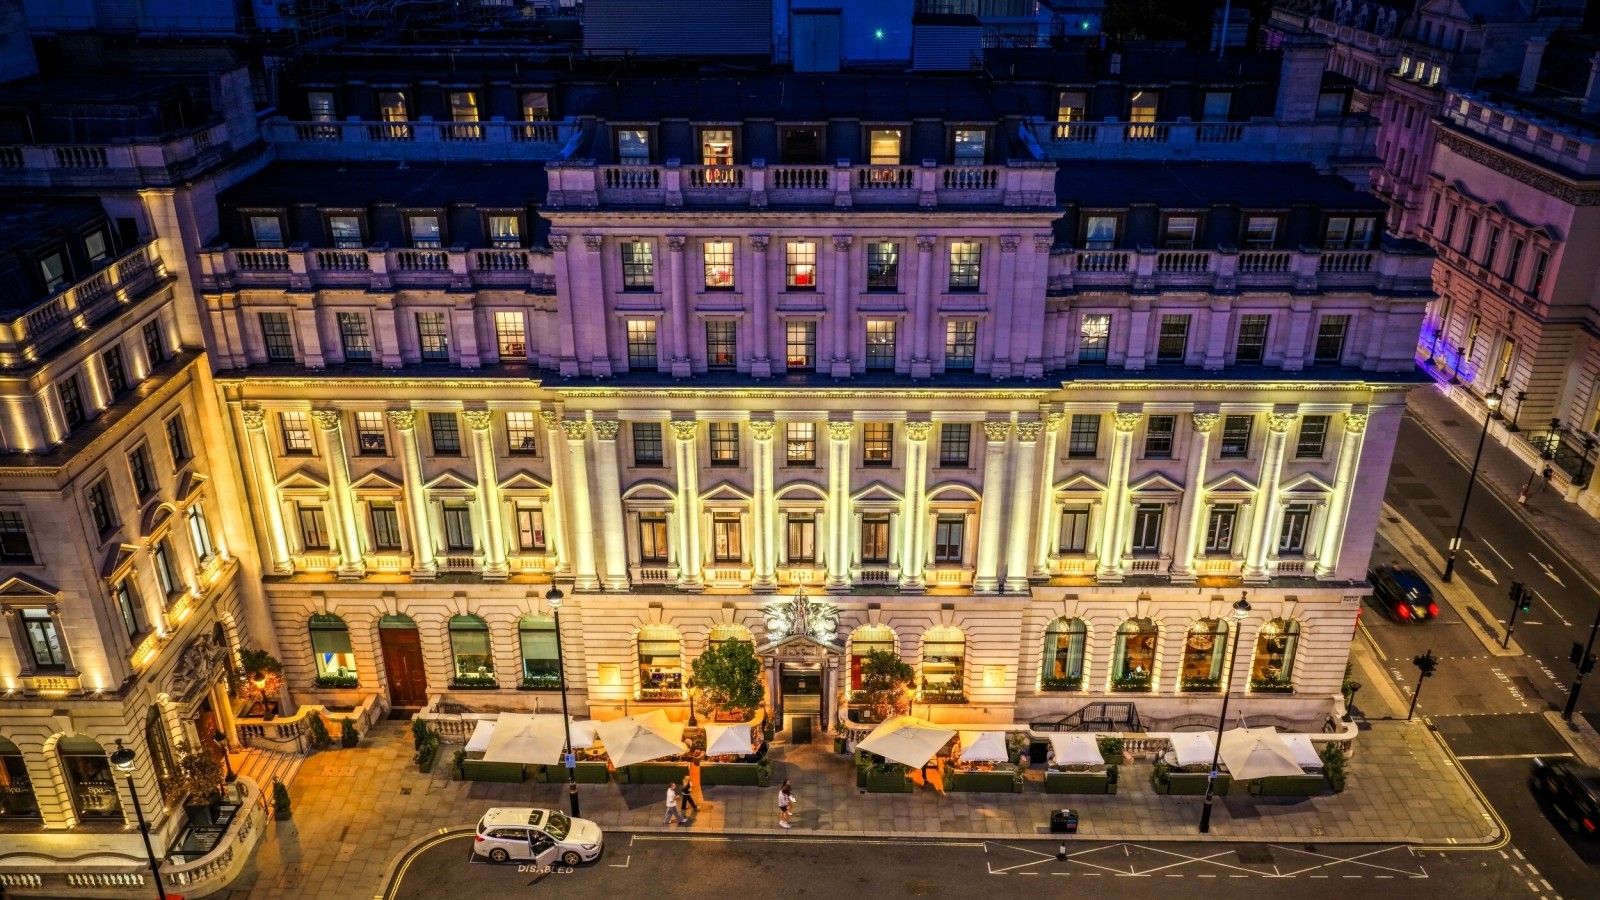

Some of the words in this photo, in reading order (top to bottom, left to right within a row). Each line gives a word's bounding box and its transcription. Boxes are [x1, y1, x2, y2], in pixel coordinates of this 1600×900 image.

[1491, 668, 1510, 683] LEFT
[1507, 686, 1524, 701] LOOK
[88, 786, 106, 795] Spa
